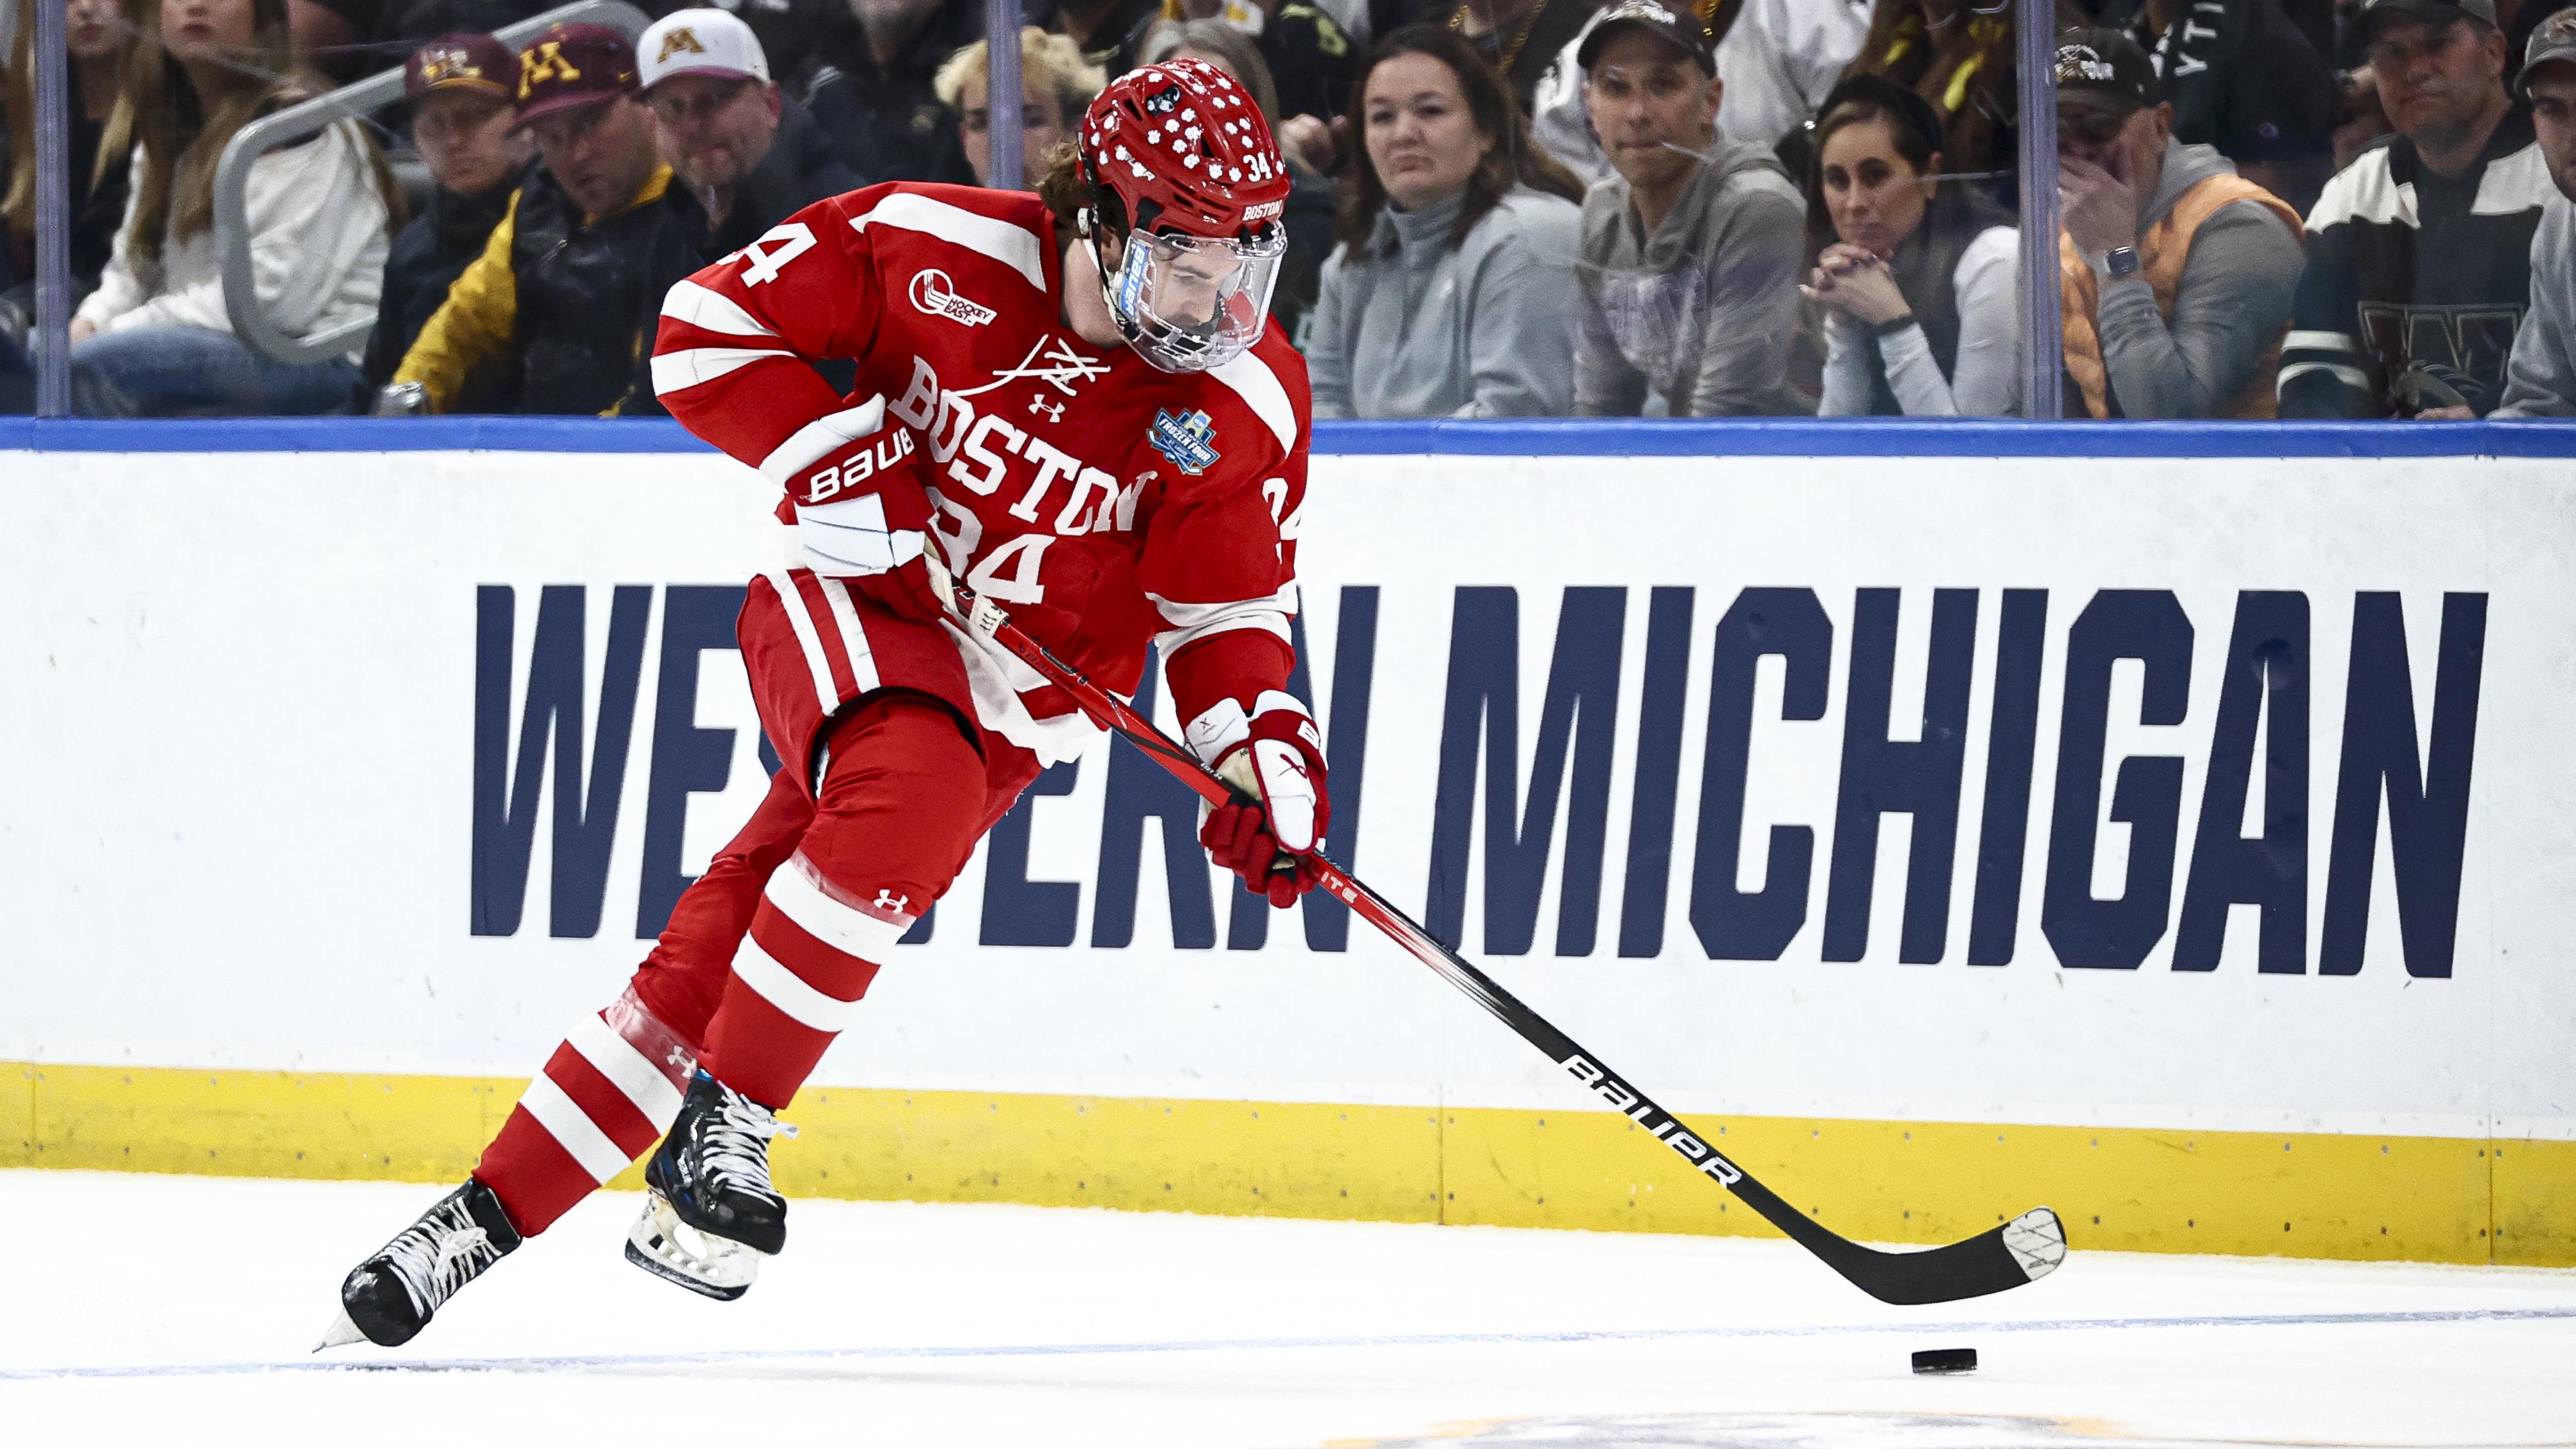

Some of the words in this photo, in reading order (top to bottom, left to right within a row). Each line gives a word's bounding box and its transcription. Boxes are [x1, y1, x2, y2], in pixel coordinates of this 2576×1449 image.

[517, 41, 581, 100] M
[657, 27, 705, 63] M
[1243, 152, 1273, 182] 34
[1242, 200, 1283, 221] BOSTON
[715, 222, 818, 288] 4
[1125, 244, 1146, 317] BAUER
[943, 304, 971, 321] EAST
[948, 297, 991, 320] HOCKEY
[810, 427, 915, 503] BAUE
[887, 354, 1158, 536] BOSTON
[1158, 418, 1192, 447] FROZEN
[1187, 442, 1212, 463] FOUR
[1426, 585, 2489, 979] MICHIGAN
[1560, 1054, 1742, 1189] BAUER
